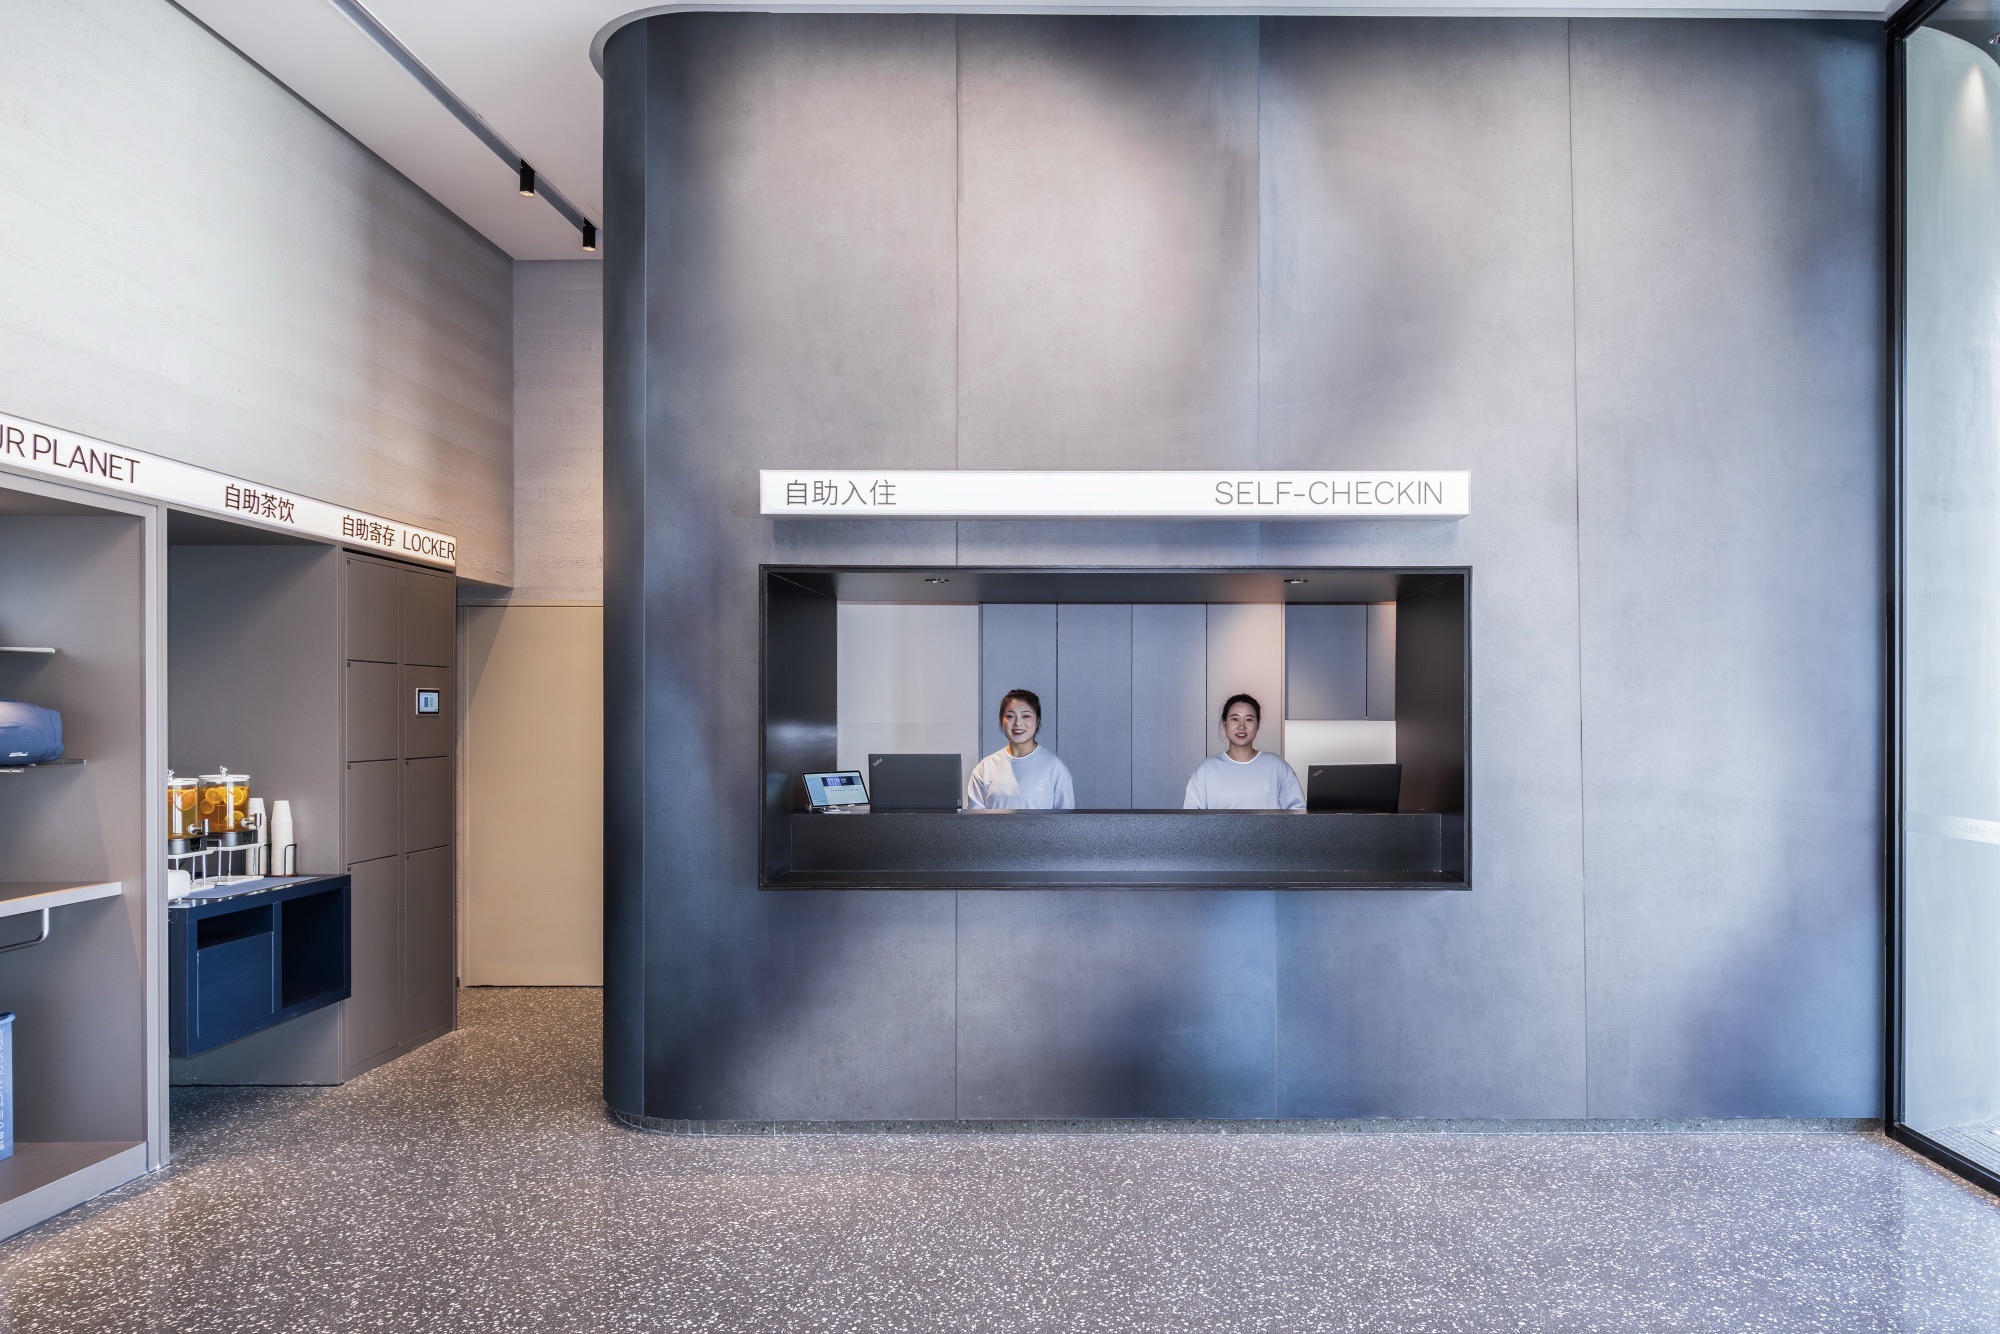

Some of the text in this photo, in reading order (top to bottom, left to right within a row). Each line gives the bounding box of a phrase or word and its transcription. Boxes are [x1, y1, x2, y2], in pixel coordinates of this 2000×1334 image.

[33, 433, 140, 483] PLANET
[225, 483, 295, 524] 自助茶饮
[785, 479, 897, 506] 自助入住
[1215, 481, 1443, 505] SELF-CHECKIN
[342, 515, 456, 560] 自助寄存 LOCKER
